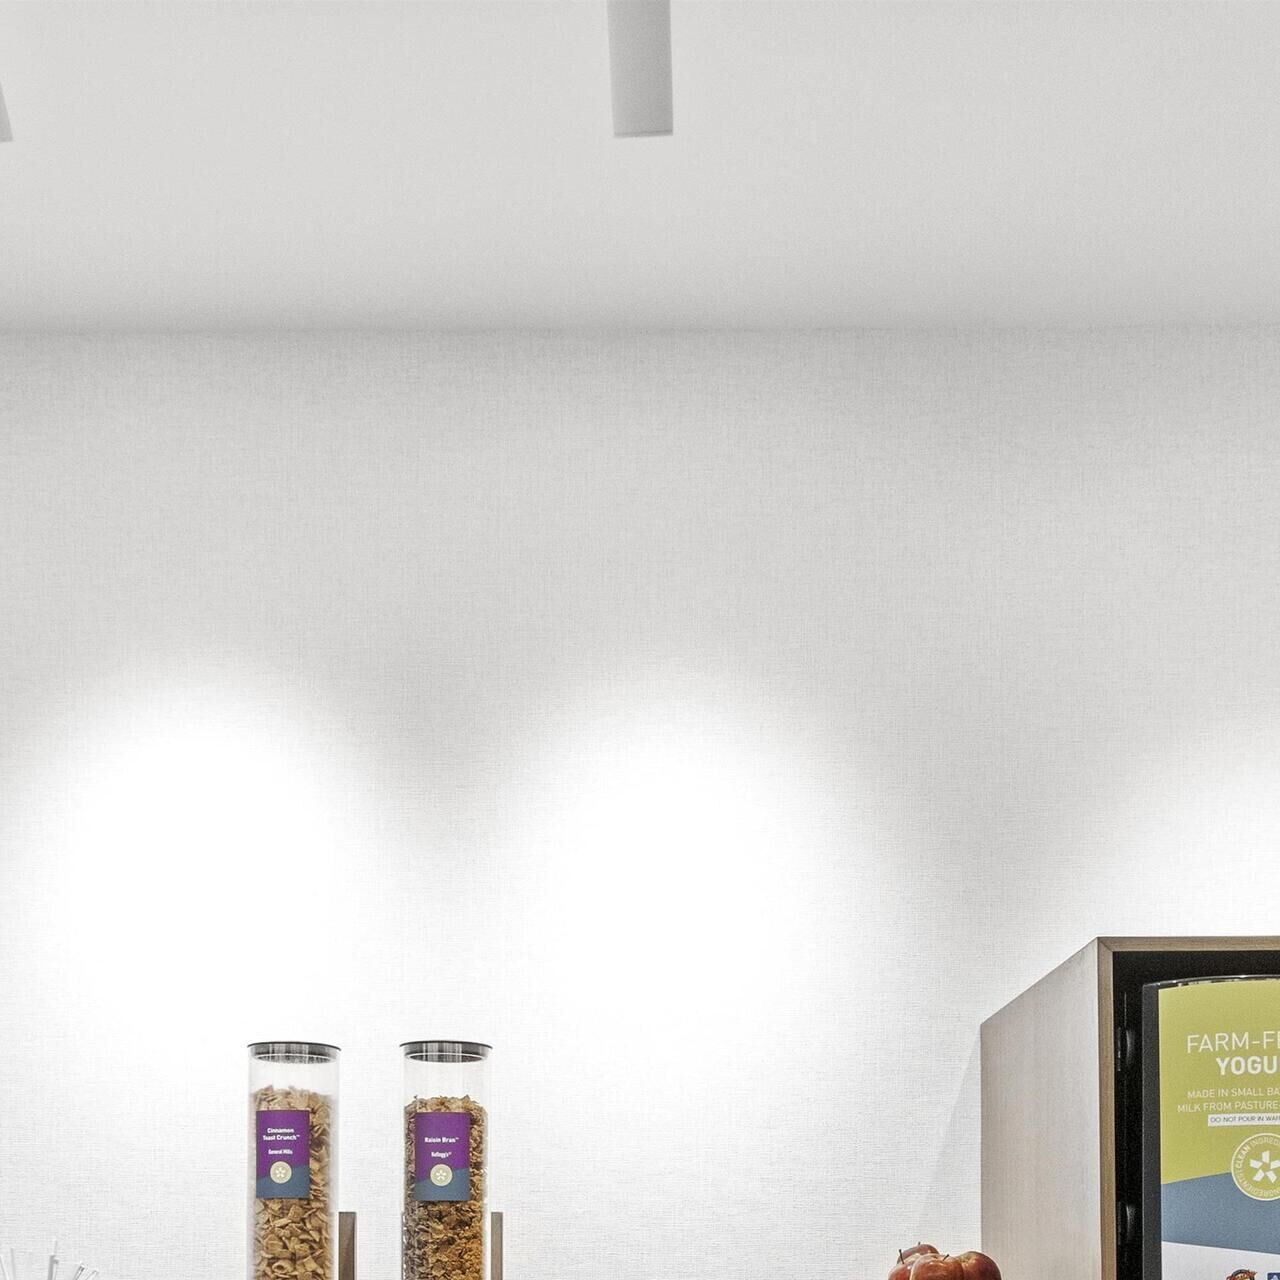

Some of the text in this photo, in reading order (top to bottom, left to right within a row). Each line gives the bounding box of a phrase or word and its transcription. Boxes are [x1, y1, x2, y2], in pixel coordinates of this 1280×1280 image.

[1187, 1088, 1216, 1099] MADE
[1218, 1088, 1229, 1098] IN
[1231, 1087, 1264, 1097] SMALL
[1177, 1103, 1201, 1113] MILK
[1203, 1102, 1232, 1112] FROM
[1210, 1116, 1221, 1124] DO
